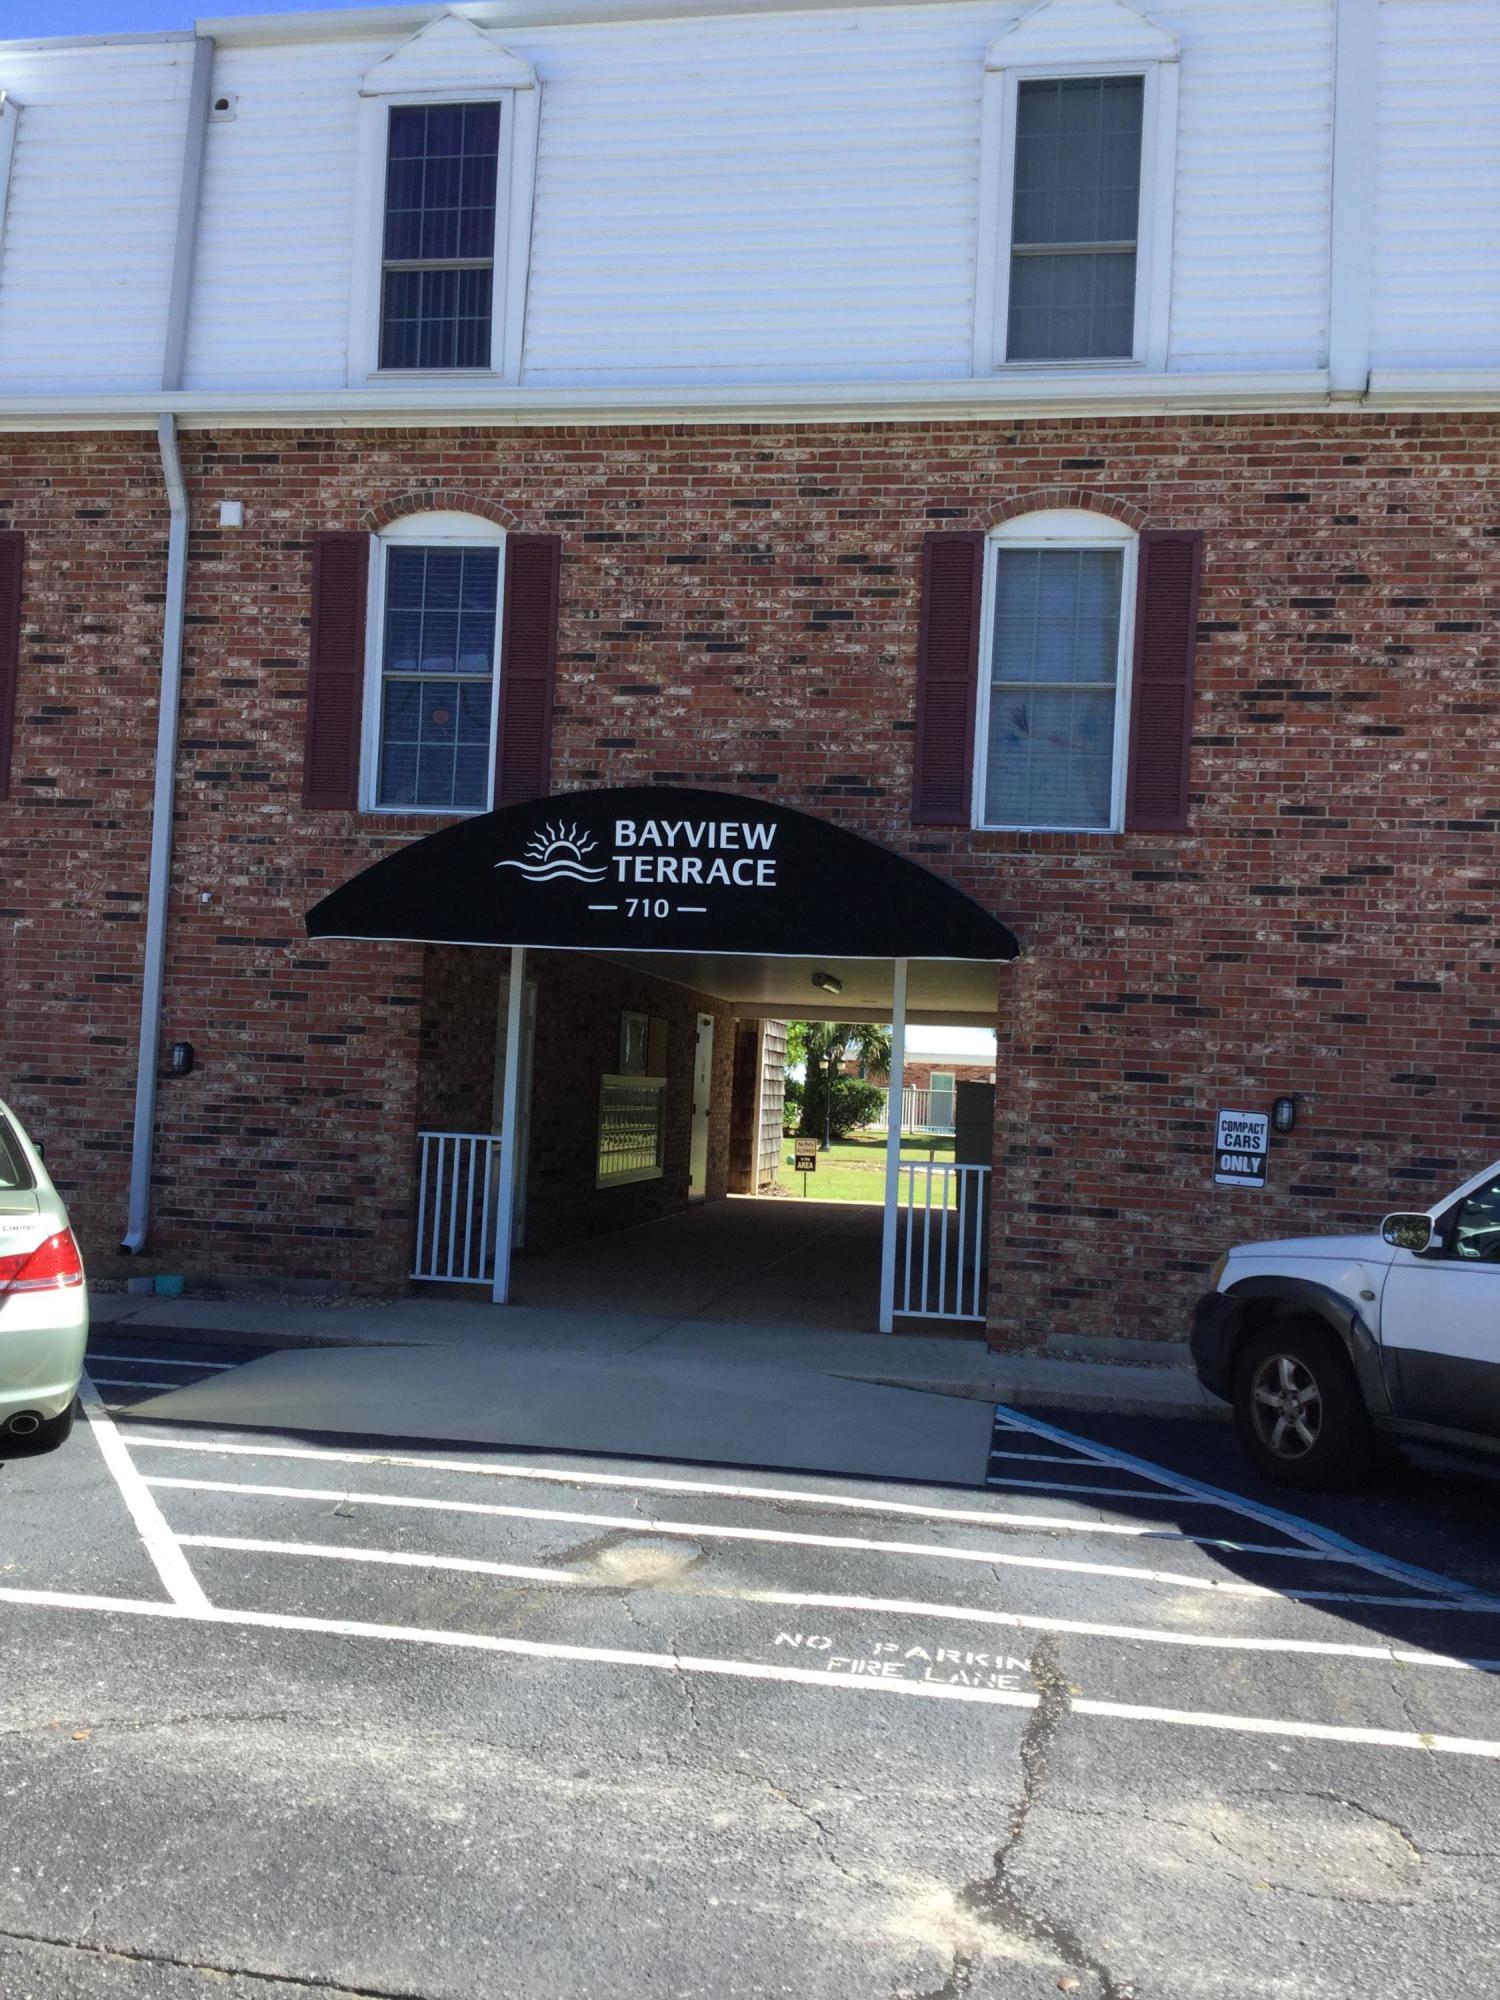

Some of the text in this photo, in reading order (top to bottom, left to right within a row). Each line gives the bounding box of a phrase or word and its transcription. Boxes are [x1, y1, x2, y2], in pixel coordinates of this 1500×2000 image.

[614, 819, 777, 850] BAYVIEW
[612, 855, 777, 887] TERRACE
[625, 898, 669, 918] 710
[1221, 1120, 1266, 1135] COMPACT
[1224, 1133, 1261, 1150] CARS
[797, 1161, 814, 1169] AREA
[1220, 1154, 1262, 1173] ONLY
[774, 1631, 1033, 1672] NO PARKIN
[826, 1656, 1021, 1690] FIRE LANE
